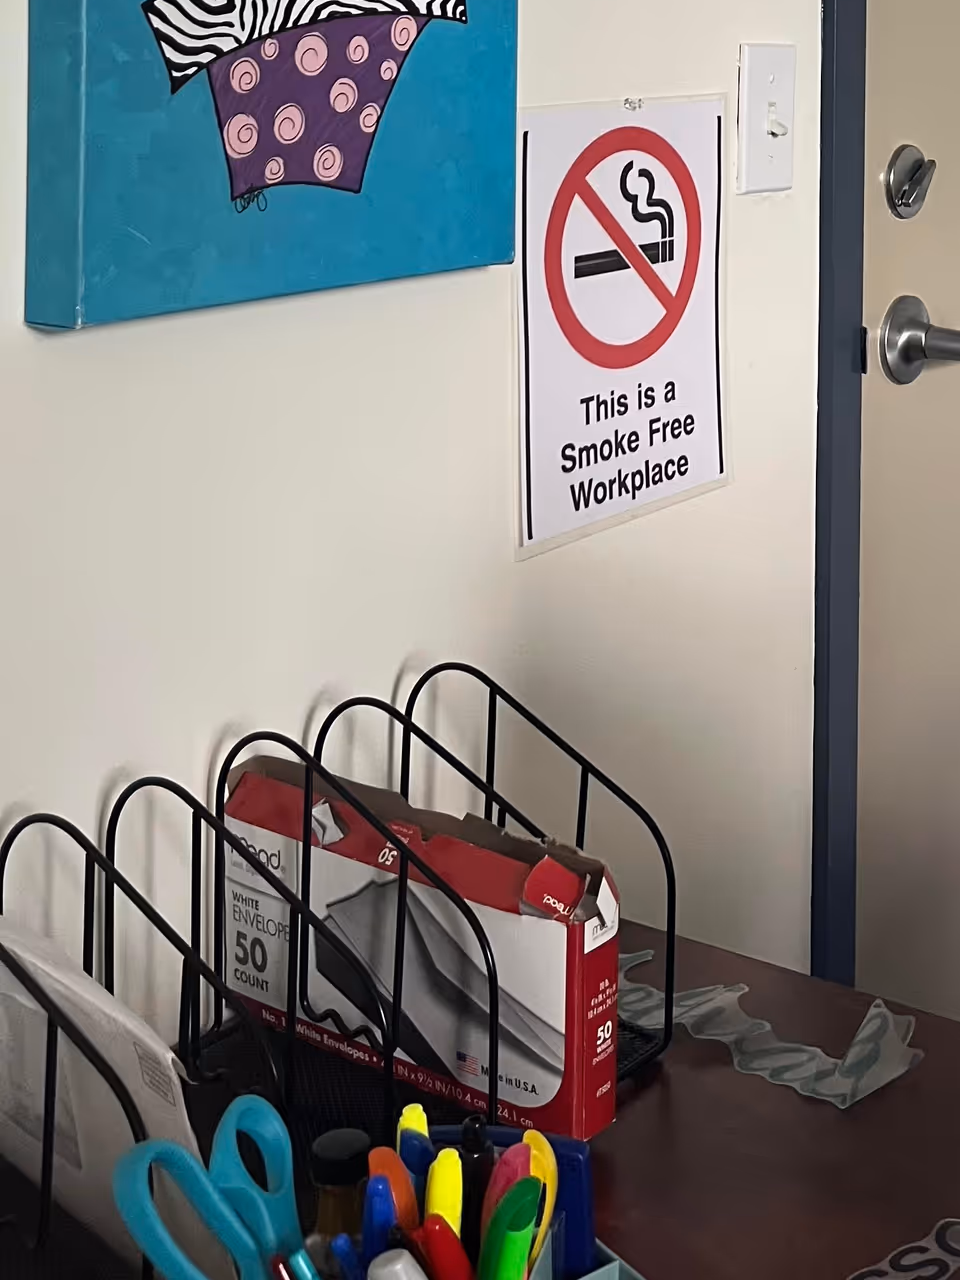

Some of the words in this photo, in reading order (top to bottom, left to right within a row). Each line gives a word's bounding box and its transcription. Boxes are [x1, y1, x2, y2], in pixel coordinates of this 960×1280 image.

[580, 390, 629, 425] This
[637, 382, 656, 410] is
[664, 381, 676, 403] a
[561, 429, 640, 473] Smoke
[649, 414, 695, 447] Free
[570, 455, 689, 512] Workplace
[378, 848, 397, 865] 50
[232, 890, 259, 911] WHITE
[232, 904, 290, 943] ENVELOPE
[235, 930, 268, 973] 50
[234, 968, 269, 993] COUNT
[296, 1024, 321, 1041] White
[324, 1034, 369, 1061] Envelopes
[597, 1021, 612, 1045] 50
[481, 1064, 503, 1082] Me
[505, 1074, 514, 1086] in
